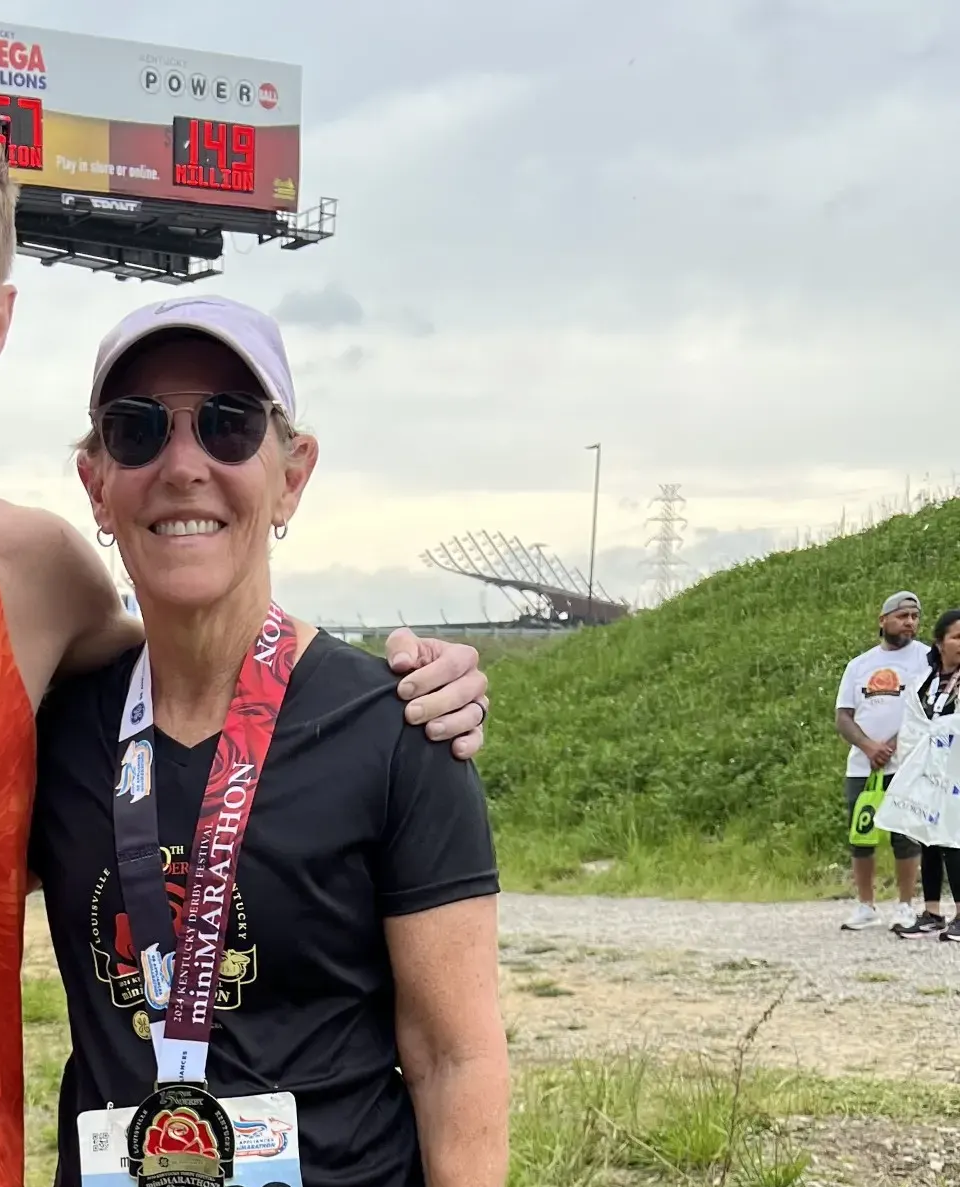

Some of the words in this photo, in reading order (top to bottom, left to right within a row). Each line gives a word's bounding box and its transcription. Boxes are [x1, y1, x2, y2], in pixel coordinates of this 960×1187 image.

[144, 71, 252, 102] POWER
[189, 118, 255, 171] 149
[55, 155, 75, 175] Play
[78, 158, 88, 172] in
[90, 160, 114, 175] store
[116, 165, 126, 177] or
[129, 164, 160, 180] online.
[175, 164, 254, 191] MILLION
[195, 822, 214, 878] FESTIVAL
[91, 867, 111, 944] LOUISVILLE
[189, 761, 255, 1025] miniMARATHON
[189, 883, 202, 922] DERBY
[177, 927, 196, 994] KENTUCKY
[174, 998, 184, 1022] 2024
[133, 1109, 148, 1154] LOUISVILLE
[214, 1110, 230, 1152] KENTUCKY
